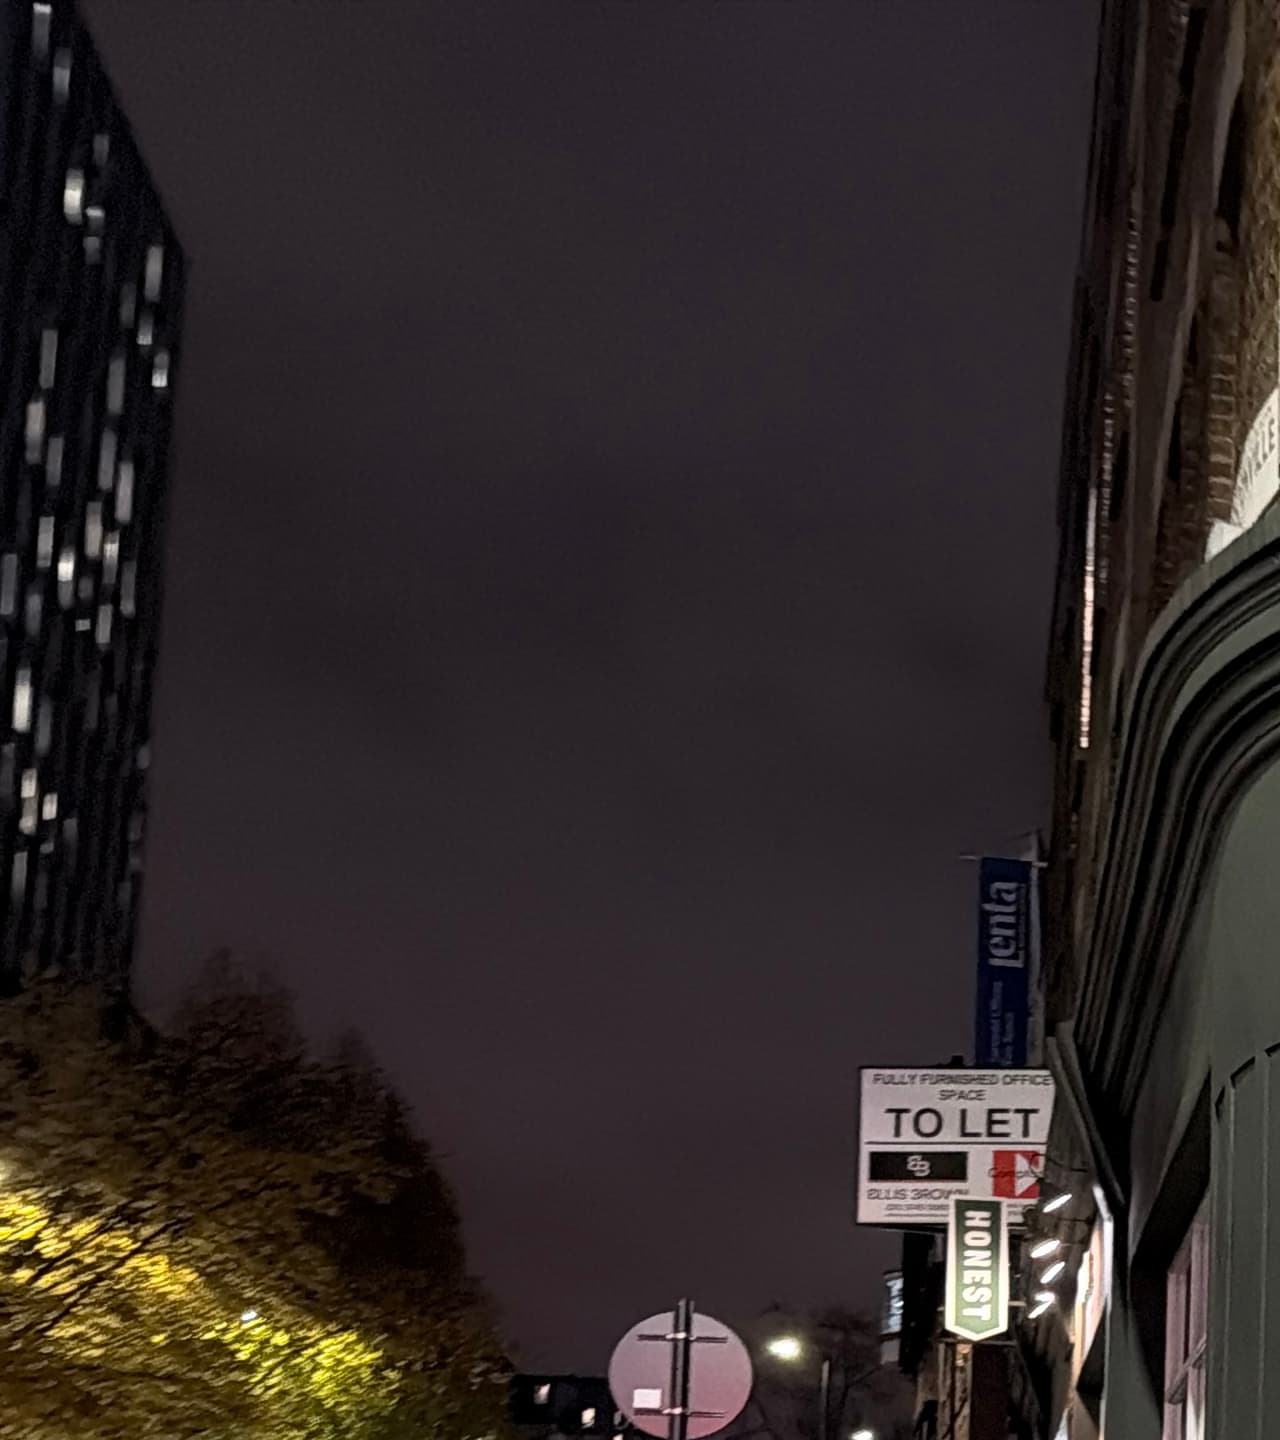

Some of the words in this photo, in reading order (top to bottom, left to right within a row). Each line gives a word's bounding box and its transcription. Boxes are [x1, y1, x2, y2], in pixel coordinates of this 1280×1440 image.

[872, 1073, 917, 1085] FULLY
[919, 1073, 999, 1085] FURNISHED
[1002, 1074, 1054, 1086] OFFICE
[938, 1089, 986, 1101] SPACE
[884, 1107, 944, 1138] TO
[959, 1108, 1040, 1138] LET
[962, 1210, 992, 1322] HONEST
